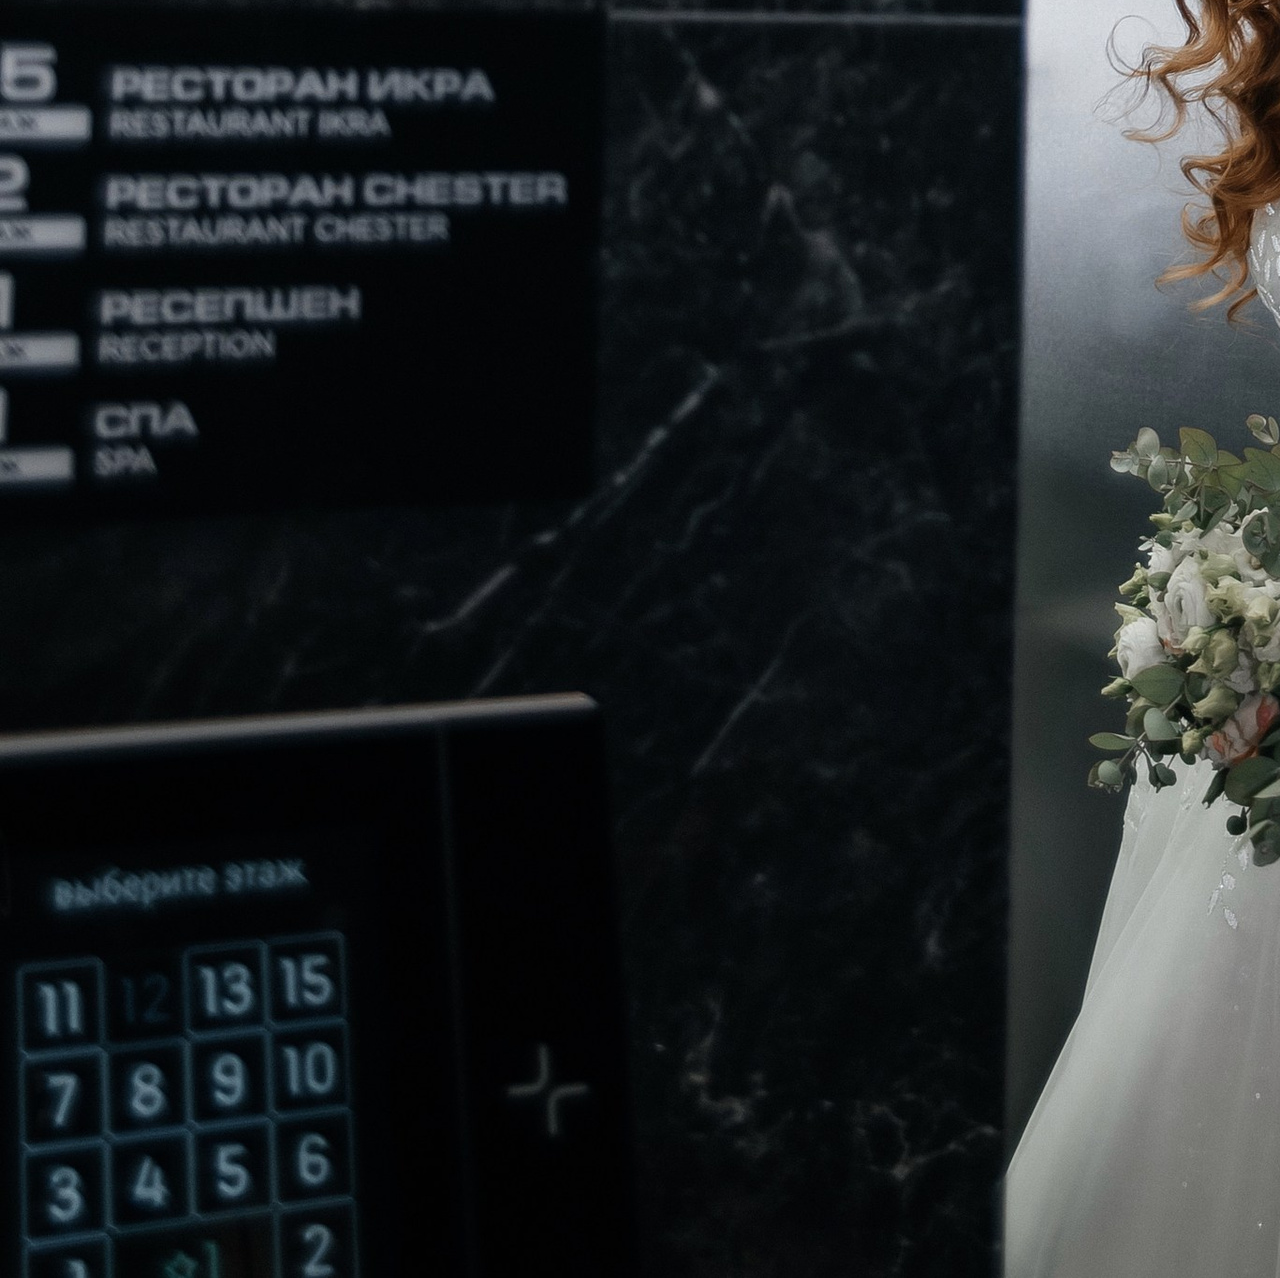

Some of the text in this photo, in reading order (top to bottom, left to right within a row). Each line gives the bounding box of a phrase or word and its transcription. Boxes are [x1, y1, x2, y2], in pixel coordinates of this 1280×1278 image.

[110, 68, 493, 102] РЕСТОРАН ИКРА
[109, 108, 389, 138] RESTAURANT IKRA
[105, 173, 566, 210] РЕСТОРАН CHESTER
[104, 213, 447, 247] RESTAURANT CHESTER
[99, 288, 360, 325] РЕСЕПШЕН
[98, 330, 274, 363] RECEPTION
[94, 403, 197, 439] СПА
[94, 446, 155, 477] SPA
[121, 974, 170, 1024] 12
[201, 964, 253, 1015] 13
[281, 955, 333, 1005] 15
[40, 982, 81, 1035] 11
[130, 1064, 165, 1118] 8
[212, 1054, 245, 1106] 9
[284, 1043, 335, 1094] 10
[47, 1073, 81, 1127] 7
[132, 1158, 168, 1206] 4
[216, 1145, 249, 1198] 5
[297, 1134, 330, 1185] 6
[49, 1167, 82, 1222] 3
[302, 1224, 333, 1278] 2
